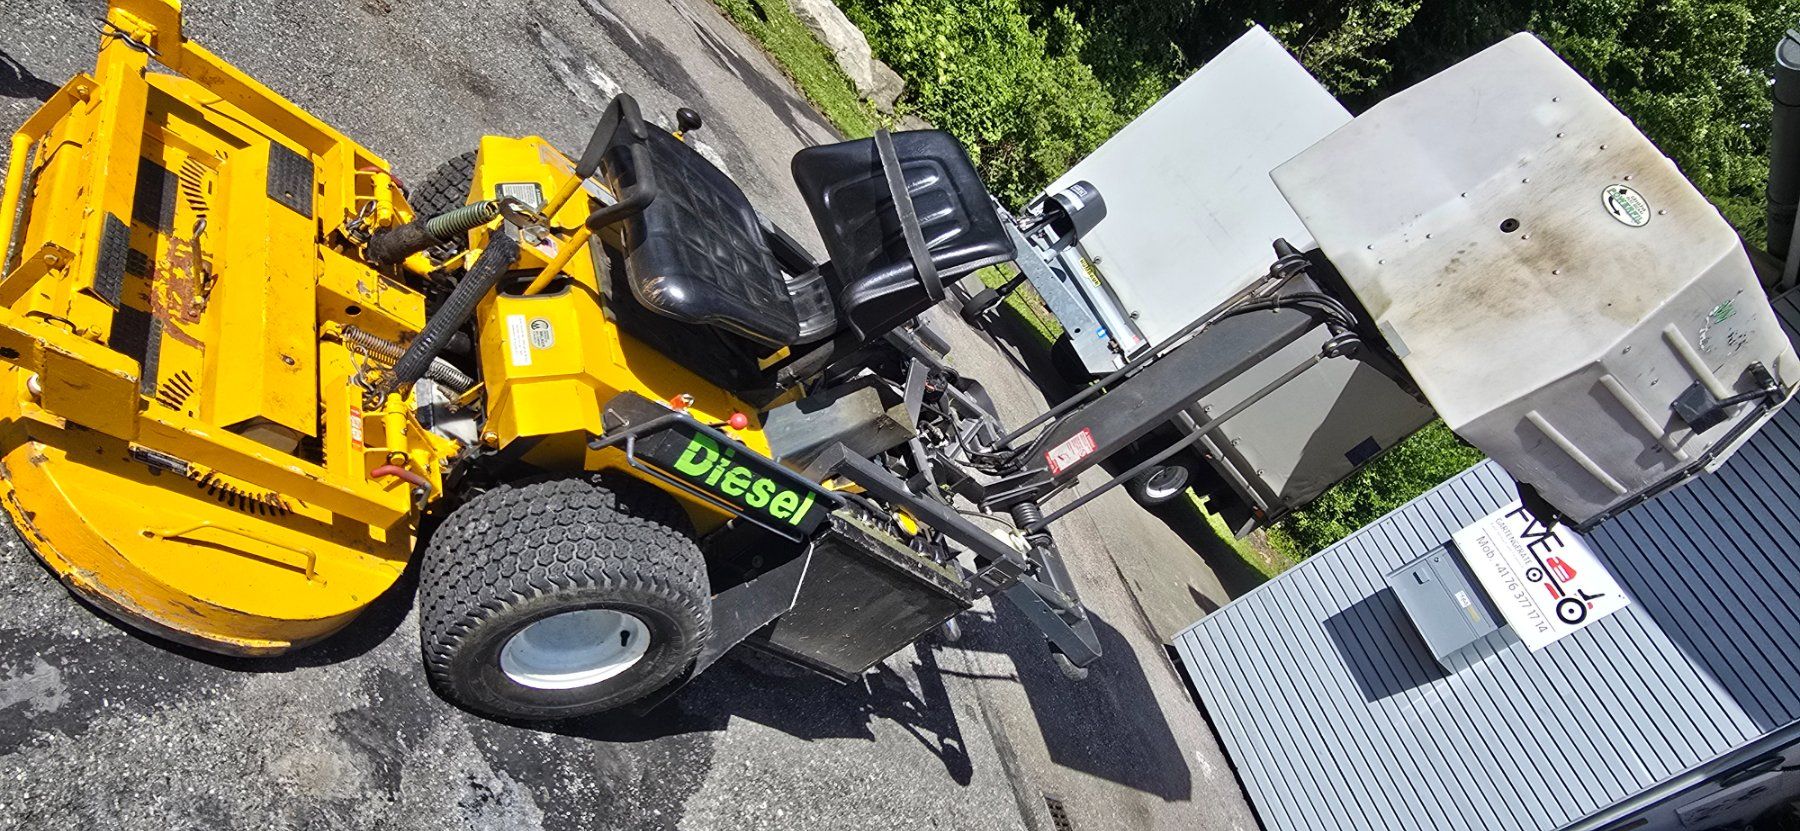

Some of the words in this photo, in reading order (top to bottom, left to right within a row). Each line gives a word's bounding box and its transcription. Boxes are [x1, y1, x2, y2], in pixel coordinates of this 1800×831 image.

[674, 432, 816, 526] Diesel
[1476, 536, 1495, 560] Mob.
[1495, 563, 1509, 579] +41
[1505, 576, 1519, 591] 76
[1514, 592, 1532, 609] 377
[1528, 609, 1540, 621] 17
[1536, 620, 1548, 634] 14
